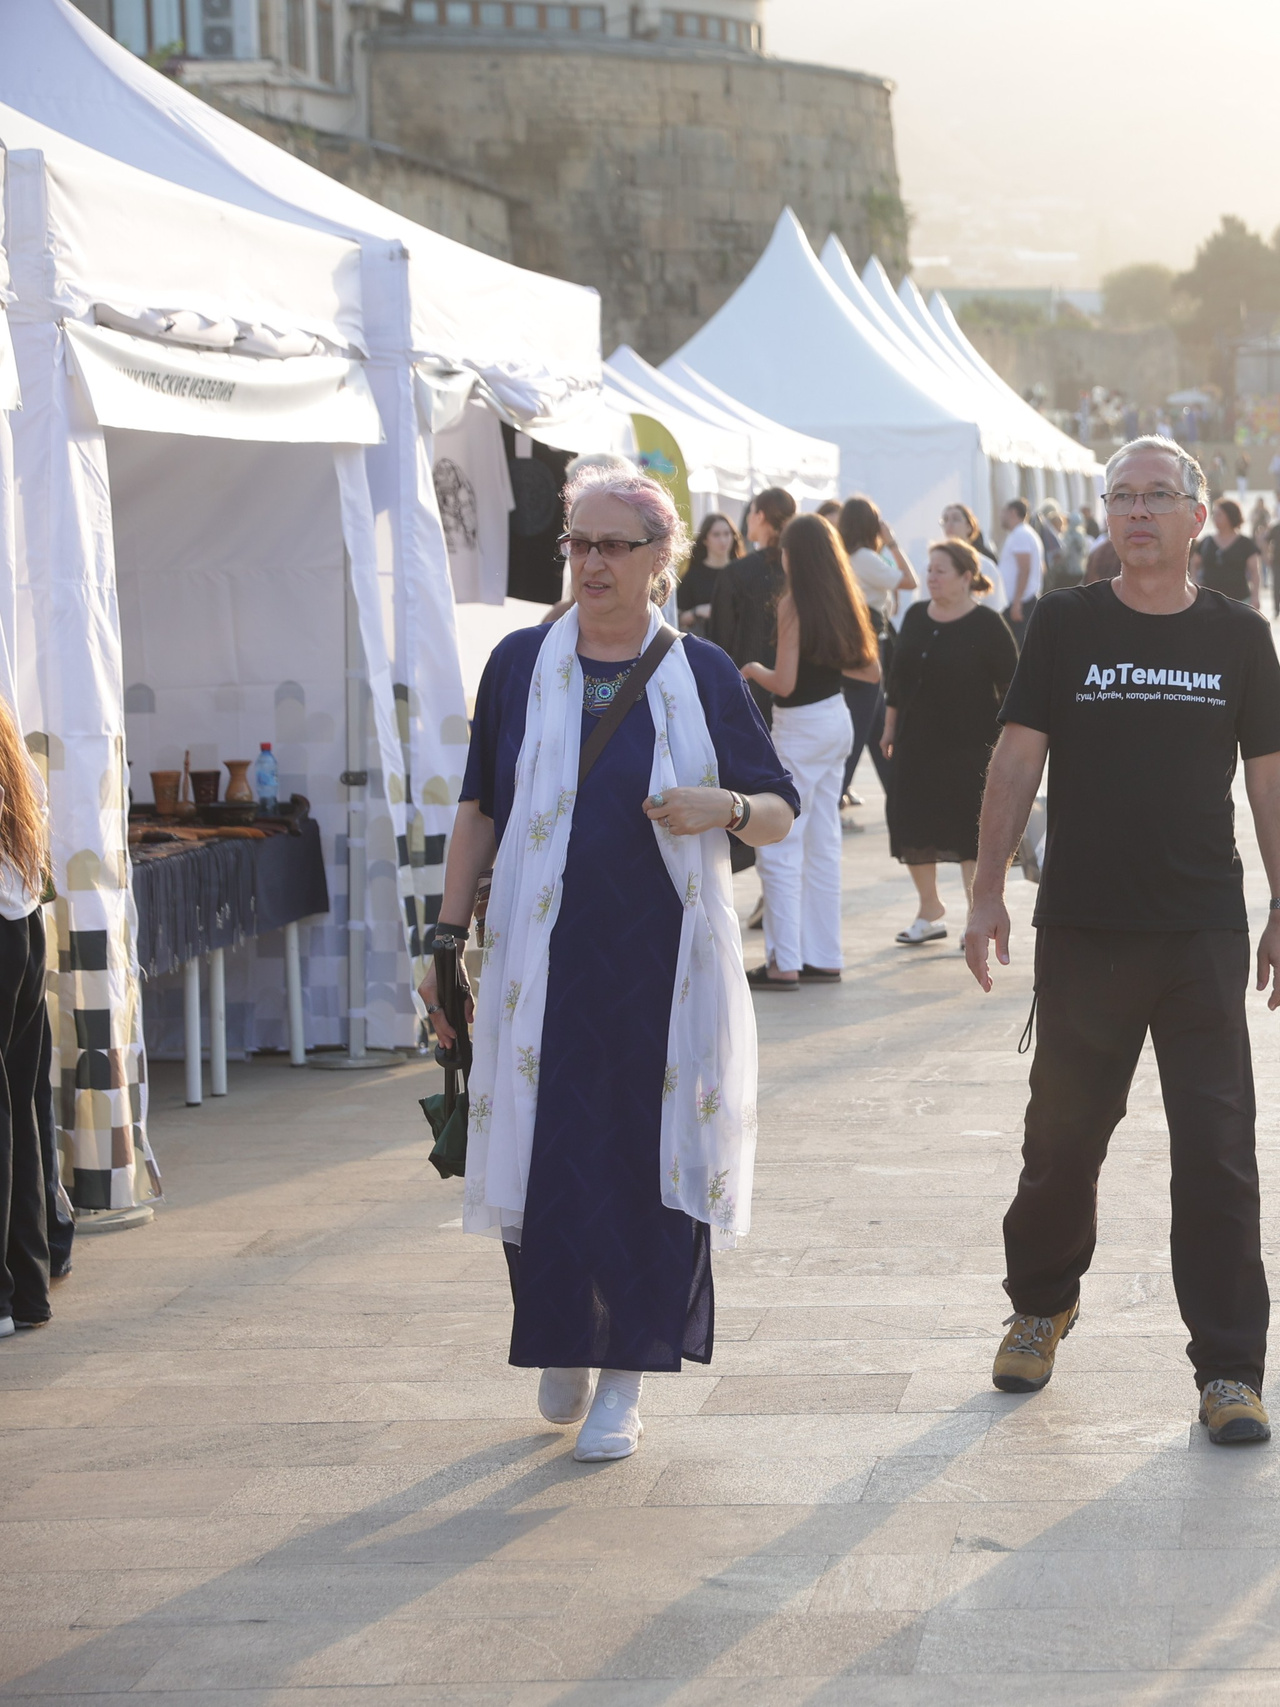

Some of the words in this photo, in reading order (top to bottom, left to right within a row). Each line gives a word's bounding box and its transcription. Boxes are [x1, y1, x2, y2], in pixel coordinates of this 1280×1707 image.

[188, 377, 236, 404] ИЗДЕЛИЯ
[1084, 663, 1222, 691] АрТемщик
[1097, 691, 1124, 701] Артём,
[1126, 691, 1161, 702] который
[1163, 693, 1206, 703] постоянно
[1207, 697, 1227, 707] мутит
